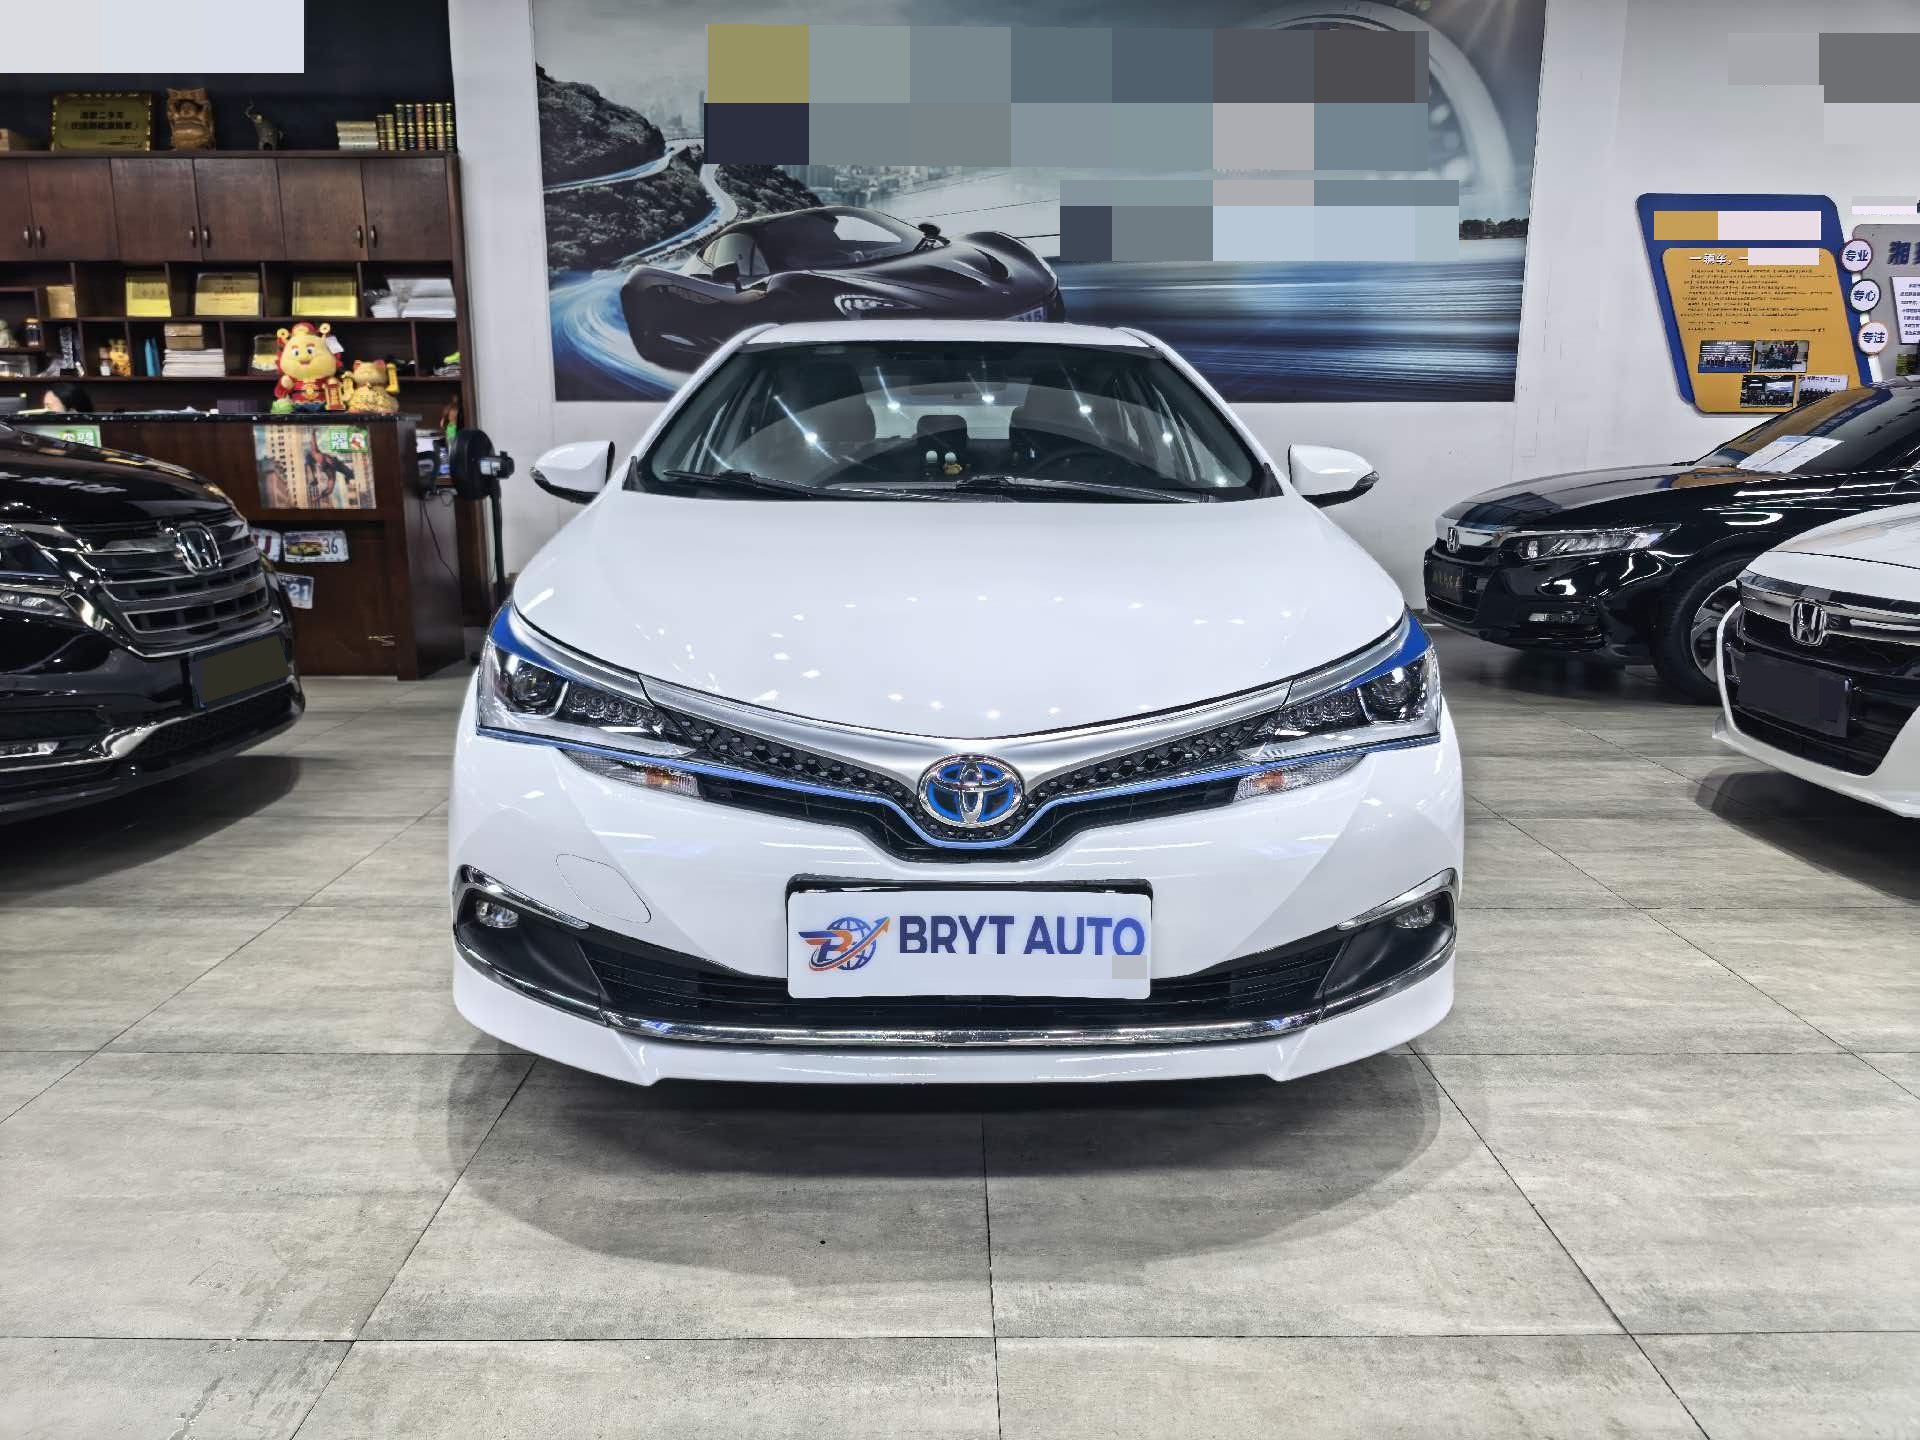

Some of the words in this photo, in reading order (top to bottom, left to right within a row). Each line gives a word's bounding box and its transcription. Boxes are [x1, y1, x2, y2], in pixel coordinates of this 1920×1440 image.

[1844, 249, 1869, 262] 专业
[1853, 289, 1876, 302] 专心
[1861, 330, 1887, 344] 专注
[899, 915, 1015, 955] BRYT
[1023, 916, 1146, 956] AUTO
